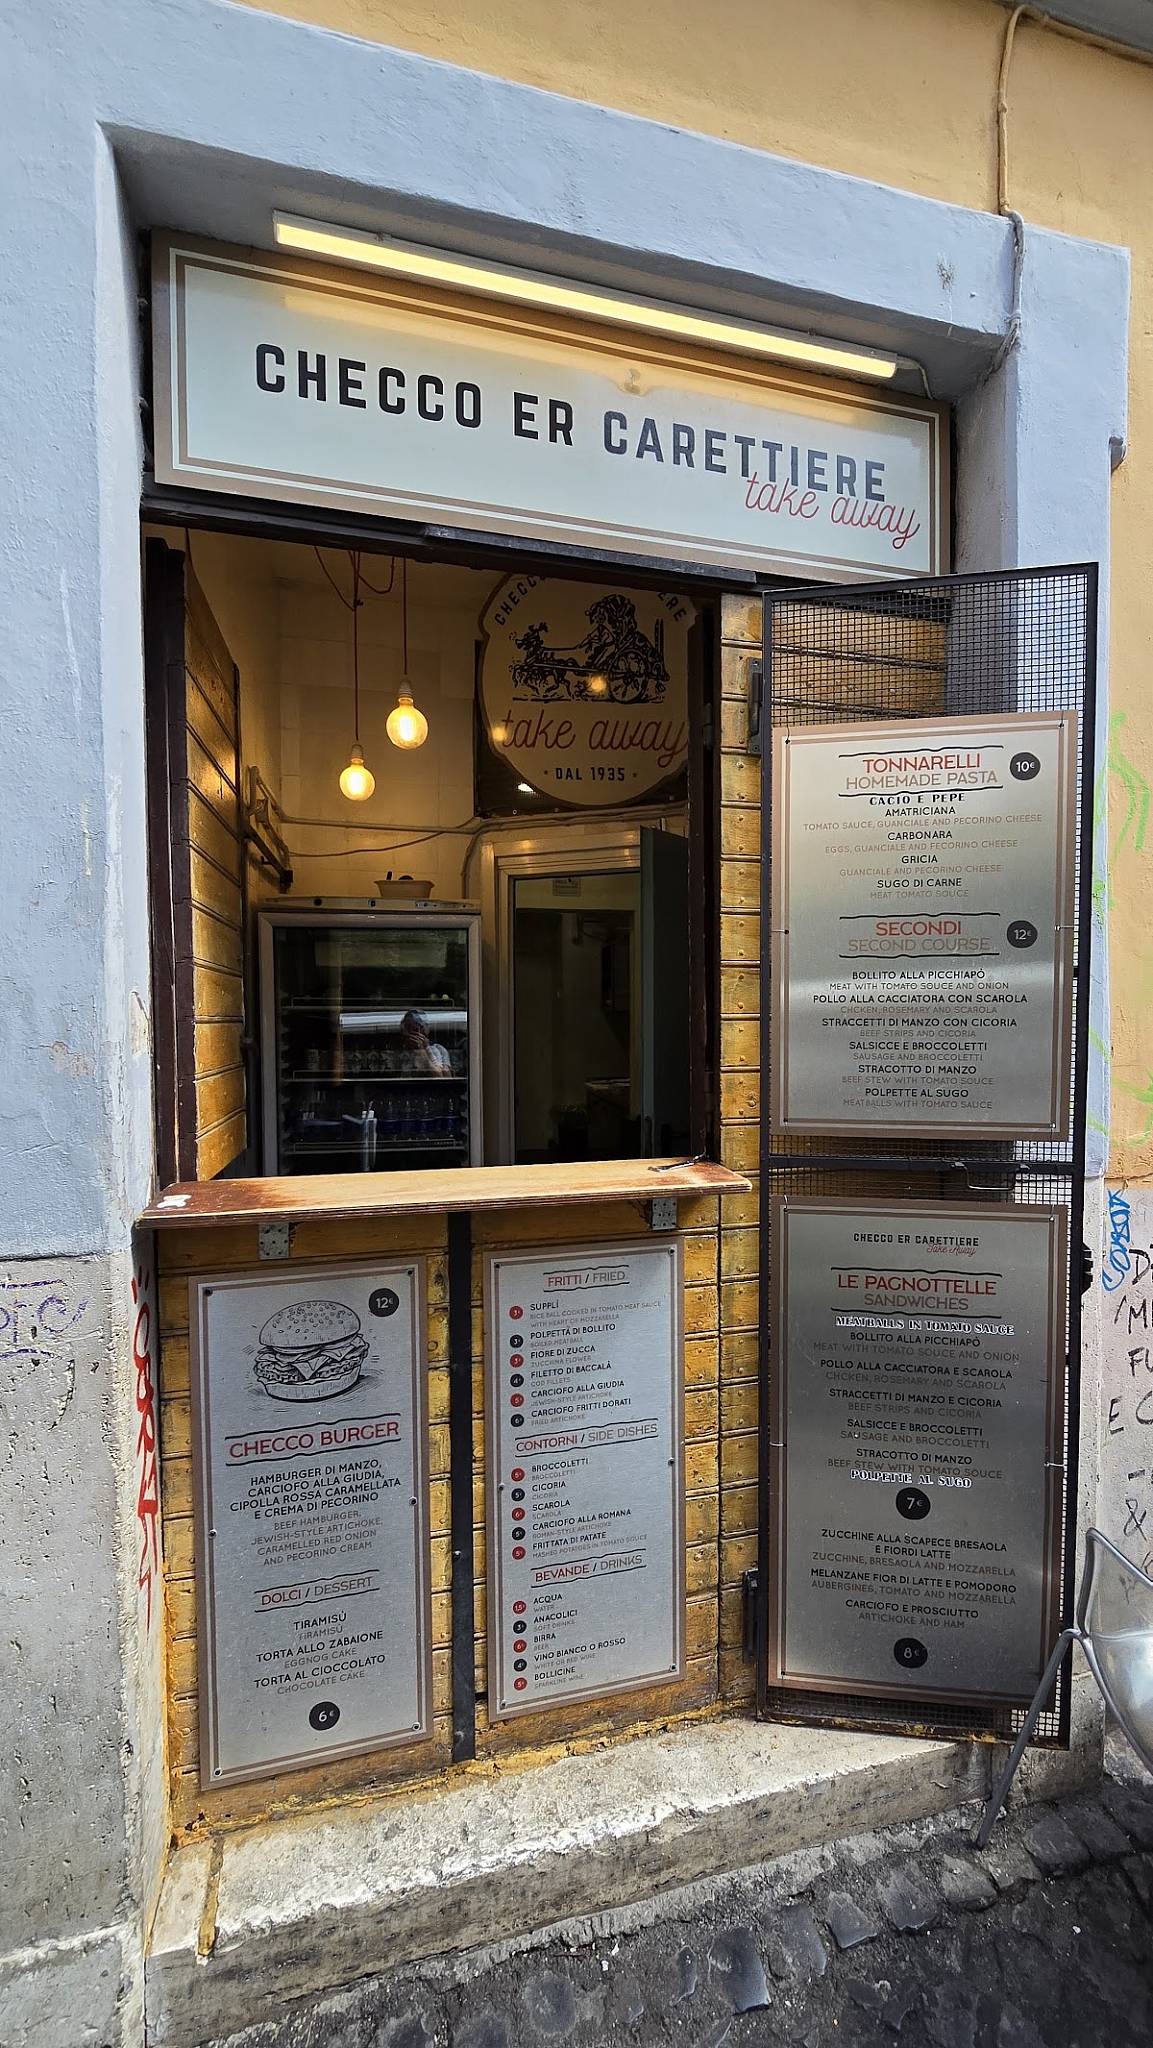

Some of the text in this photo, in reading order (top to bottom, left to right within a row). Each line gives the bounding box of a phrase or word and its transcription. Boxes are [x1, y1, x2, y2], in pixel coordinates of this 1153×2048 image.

[255, 342, 886, 503] CHECCO ER CARETTIERE
[744, 471, 920, 549] take away
[494, 575, 546, 626] CHECC
[501, 709, 689, 768] take away
[863, 753, 981, 774] TONNARELLI
[555, 767, 625, 781] DAL 1935
[846, 770, 998, 790] HOMEMADE PASTA
[870, 792, 966, 806] CACIO E PEPE
[885, 806, 956, 817] AMATRICIANA
[803, 822, 840, 832] TOMATO
[877, 817, 930, 828] GUANCIALE
[931, 816, 951, 826] AND
[953, 815, 1002, 825] PECORINO
[1005, 814, 1042, 823] CHEESE
[887, 830, 953, 841] CARBONARA
[901, 854, 938, 865] GRICIA
[877, 877, 962, 889] SUGO DI CARNE
[876, 920, 961, 937] SECONDI
[848, 938, 991, 952] SECOND COURSE
[852, 971, 897, 980] BOLLITO
[899, 970, 925, 979] ALLA
[829, 981, 1009, 991] MEAT WITH TOMATO SOUCE AND ONION
[813, 994, 1028, 1004] POLLO ALLA CACCIATORA CON SCAROLA
[821, 1017, 1017, 1027] STRACCETTI DI MANZO CON CICORIA
[849, 1041, 987, 1051] SALSICCE E BROCCOLETTI
[858, 1064, 977, 1074] STRACOTTO DI MANZO
[865, 1088, 969, 1098] POLPETTE AL SUGO
[853, 1233, 979, 1247] CHECCO ER CARETTIERE
[548, 1271, 625, 1287] FRITTI FRIED
[838, 1274, 997, 1295] LE PAGNOTTELLE
[864, 1293, 969, 1311] SANDWICHES
[835, 1315, 1015, 1336] MEATBALLS IN TOMATO SAUCE
[530, 1345, 596, 1360] FIORE DI ZUCCA
[820, 1359, 1012, 1379] POLLO ALLA CACCIATORA E SCAROLA
[531, 1380, 625, 1398] CARCIOFO ALLA GIUDIA
[229, 1421, 399, 1459] CHECCO BURGER
[516, 1423, 658, 1452] CONTORNI SIDE DISHES
[251, 1459, 382, 1486] HAMBURGER DI MANZO,
[531, 1457, 589, 1472] BROCCOLETTI
[248, 1470, 385, 1498] CARCIOFO ALLA GIUDIA,
[532, 1481, 567, 1492] CICORIA
[850, 1469, 972, 1488] POLPETTE AL SUGO
[230, 1477, 401, 1512] CIPOLLA ROSSA CARAMELLATA
[254, 1492, 379, 1520] E CREMA DI PECORINO
[532, 1499, 571, 1512] SCAROLA
[532, 1508, 632, 1531] CARCIOFO ALLA ROMANA
[251, 1527, 325, 1546] JEWISH-STYLE
[821, 1529, 1007, 1552] ZUCCHINE ALLA SCAPECE BRESAOLA
[875, 1545, 881, 1554] E
[921, 1548, 951, 1559] LATTE
[535, 1555, 642, 1583] BEVANDE DRINKS
[261, 1576, 373, 1606] DOLCI DESSERT
[533, 1593, 563, 1605] ACQUA
[533, 1609, 578, 1624] ANACOLICI
[845, 1599, 979, 1619] CARCIOFO E PROSCIUTTO
[256, 1630, 384, 1663] TORTA ALLO ZABAIONE
[533, 1633, 557, 1643] BIRRA
[534, 1637, 626, 1662] VINO BIANCO O ROSSO
[254, 1654, 386, 1689] TORTA AL CIOCCOLATO
[534, 1666, 576, 1681] BOLLICINE
